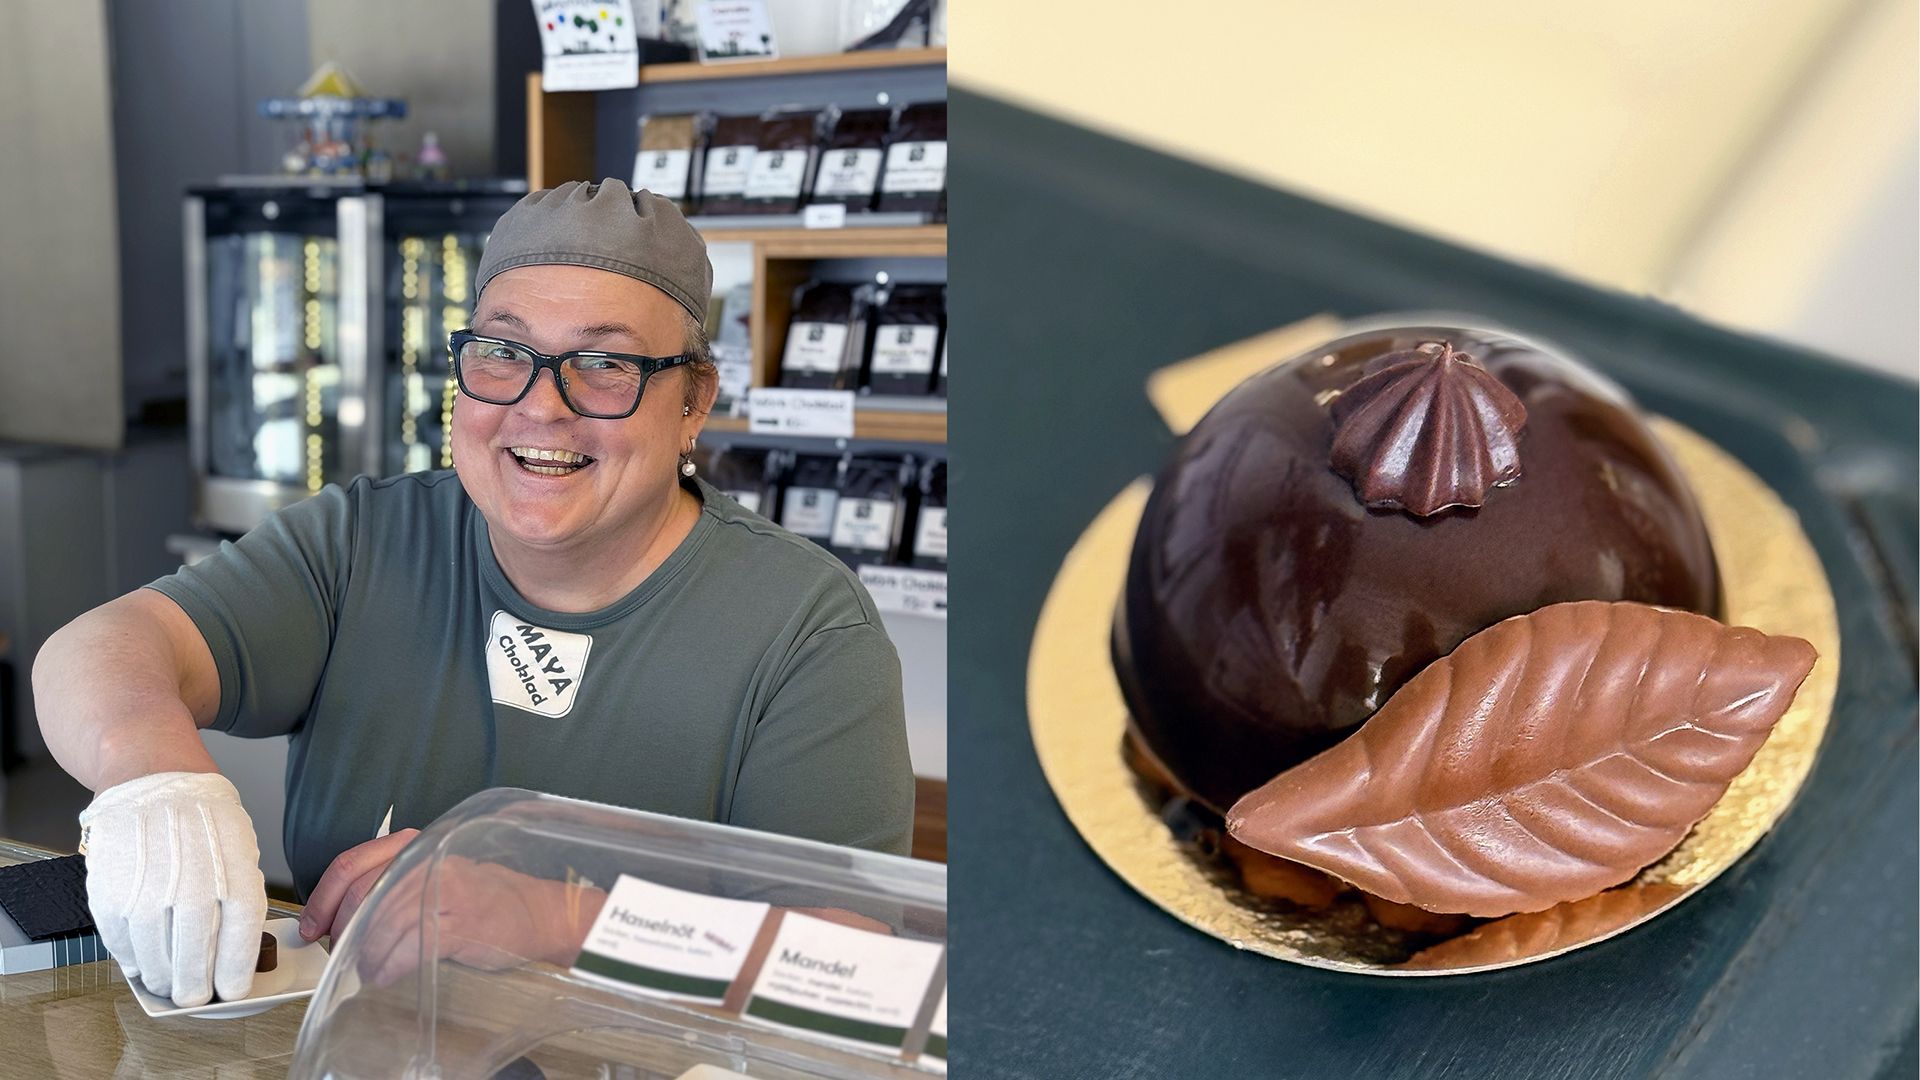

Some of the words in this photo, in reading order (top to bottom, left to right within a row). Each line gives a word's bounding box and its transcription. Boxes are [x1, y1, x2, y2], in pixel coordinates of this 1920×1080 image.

[499, 635, 548, 706] Choklad
[516, 625, 573, 696] MAYA
[609, 906, 697, 939] Hasselnöt
[779, 948, 858, 979] Mandel
